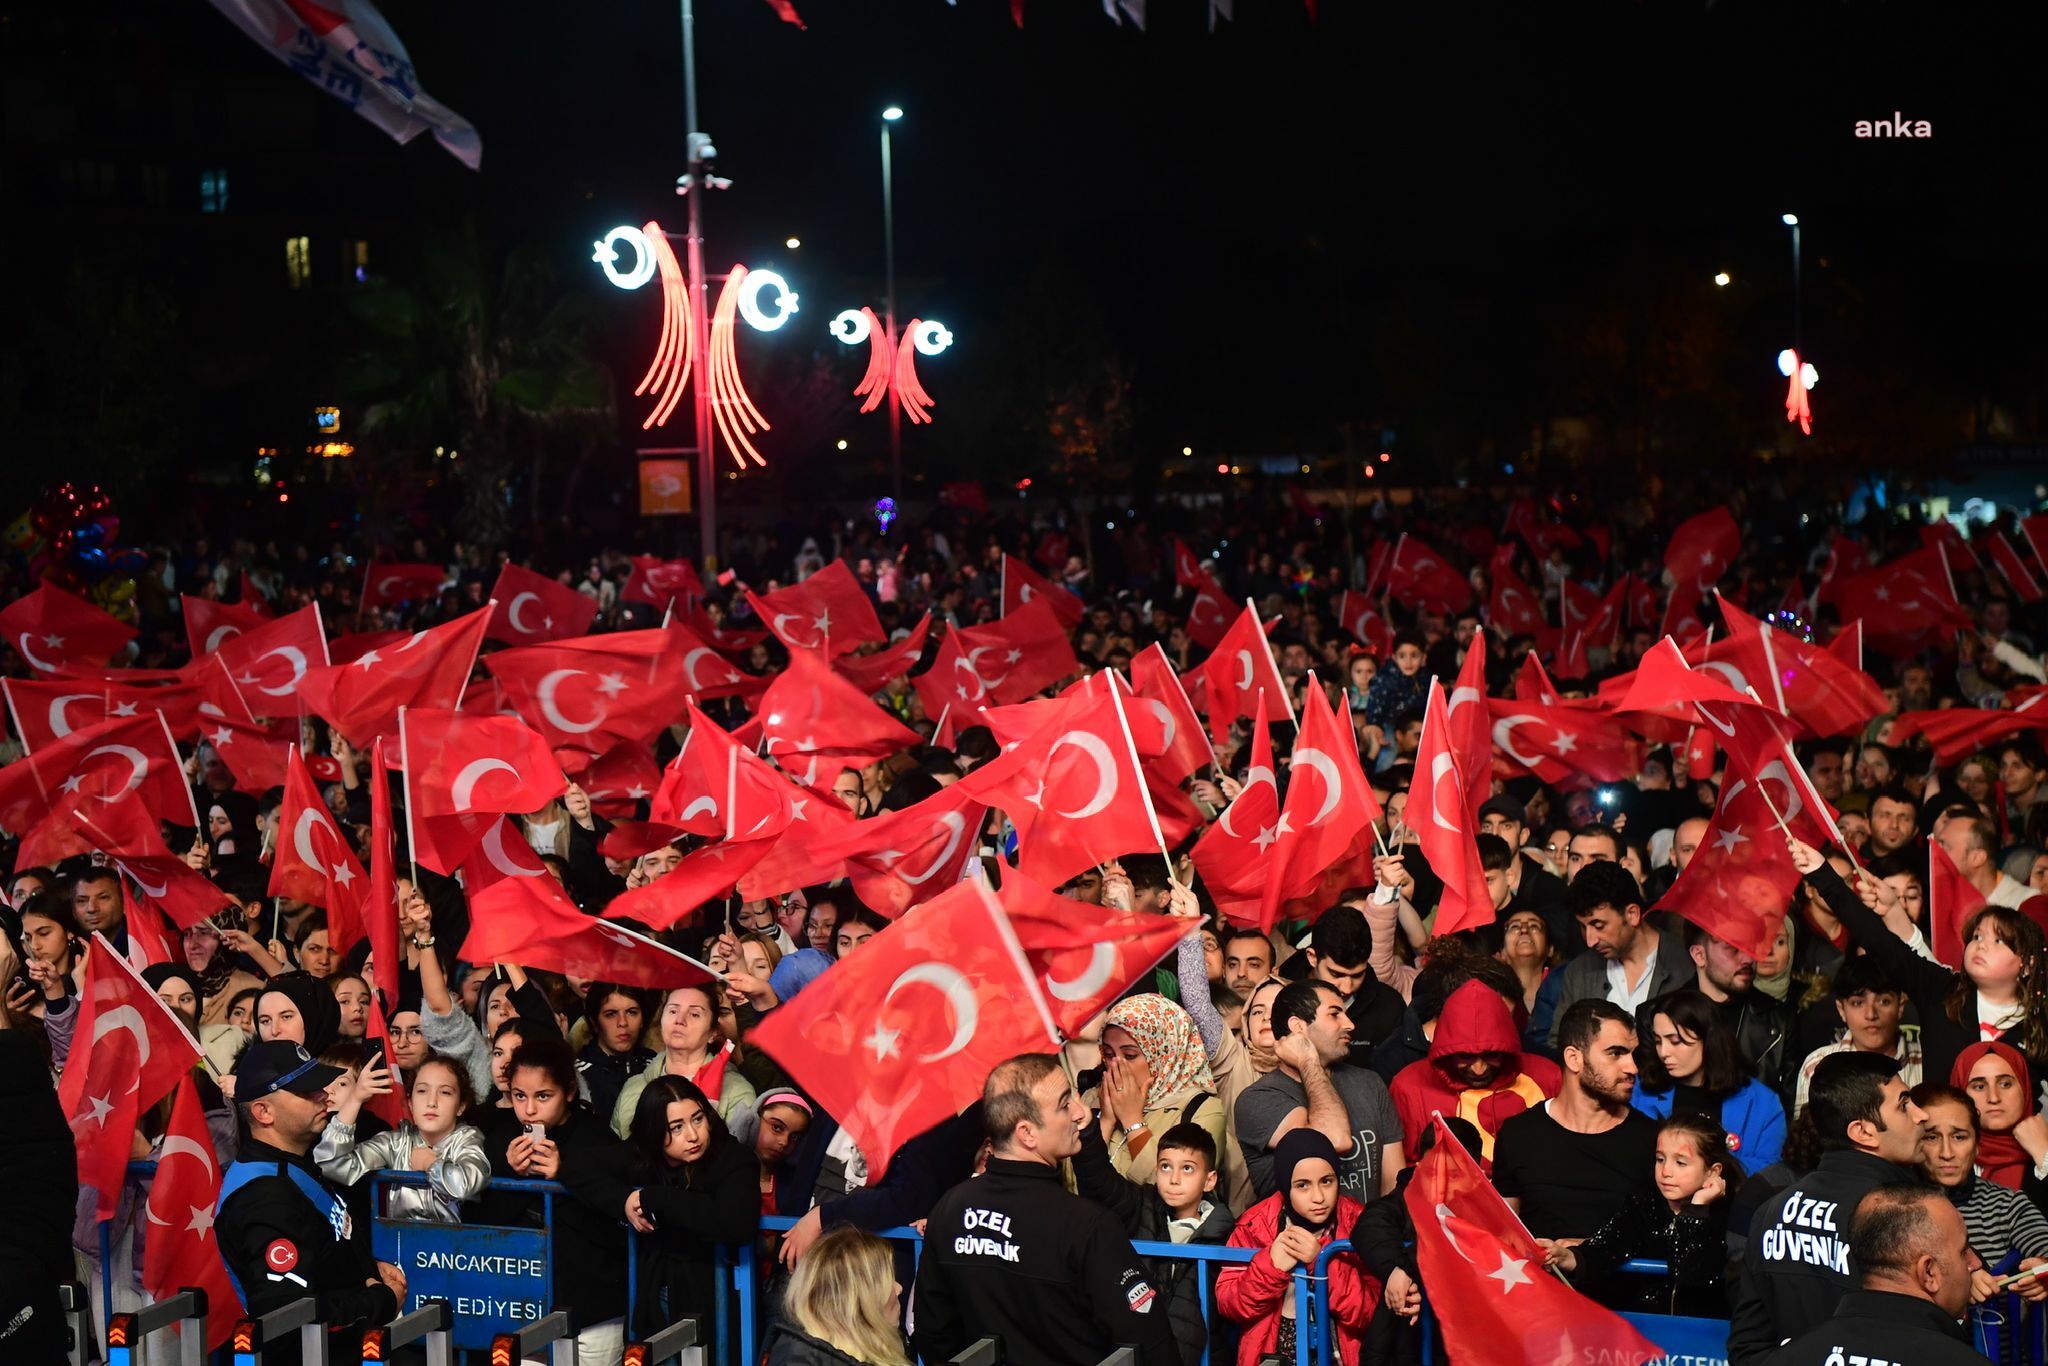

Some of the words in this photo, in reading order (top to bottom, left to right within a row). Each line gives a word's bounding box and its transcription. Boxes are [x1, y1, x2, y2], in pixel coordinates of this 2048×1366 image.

[964, 1207, 1012, 1238] ÖZEL
[1782, 1190, 1838, 1232] ÖZEL
[416, 1251, 542, 1277] SANCAKTEPE
[415, 1294, 542, 1320] BEDİYESİ
